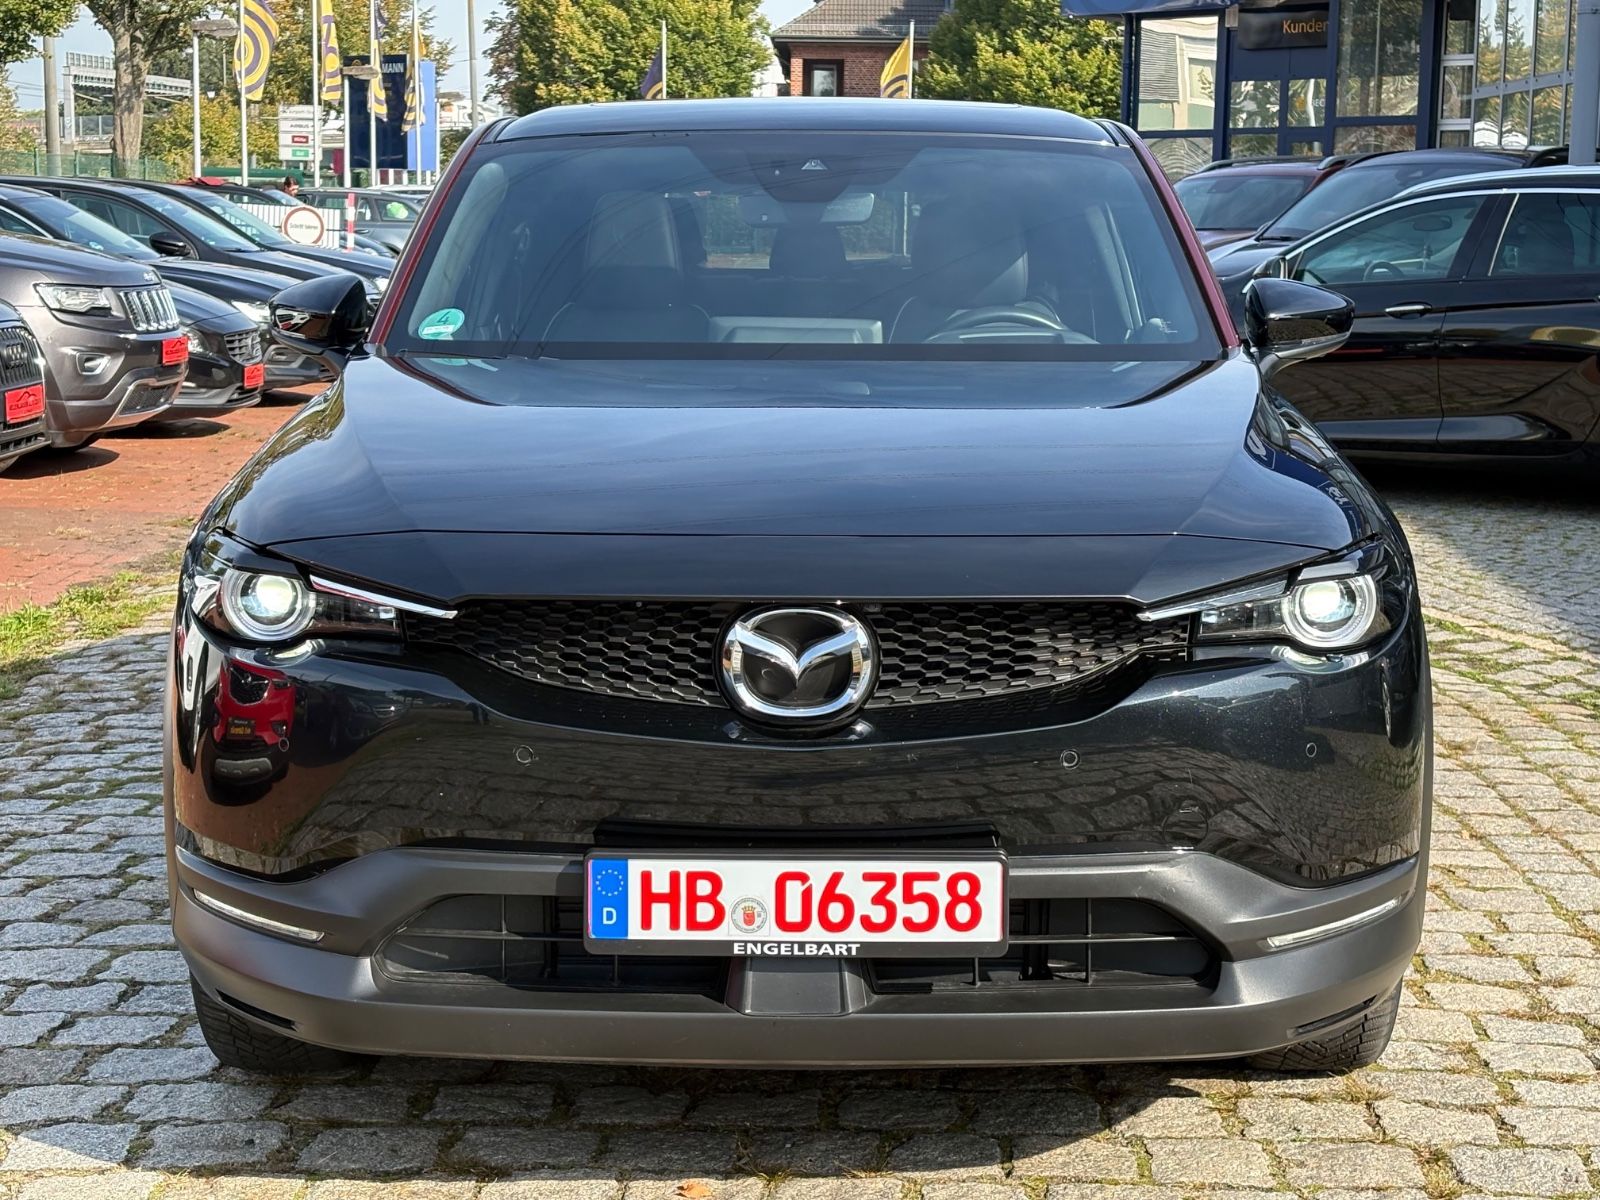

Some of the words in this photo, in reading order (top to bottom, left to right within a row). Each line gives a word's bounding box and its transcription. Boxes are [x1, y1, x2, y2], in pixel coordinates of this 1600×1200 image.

[436, 310, 452, 325] 4
[602, 907, 617, 925] D
[640, 870, 726, 931] HB
[774, 871, 983, 933] 06358
[733, 942, 861, 956] ENGELBART
